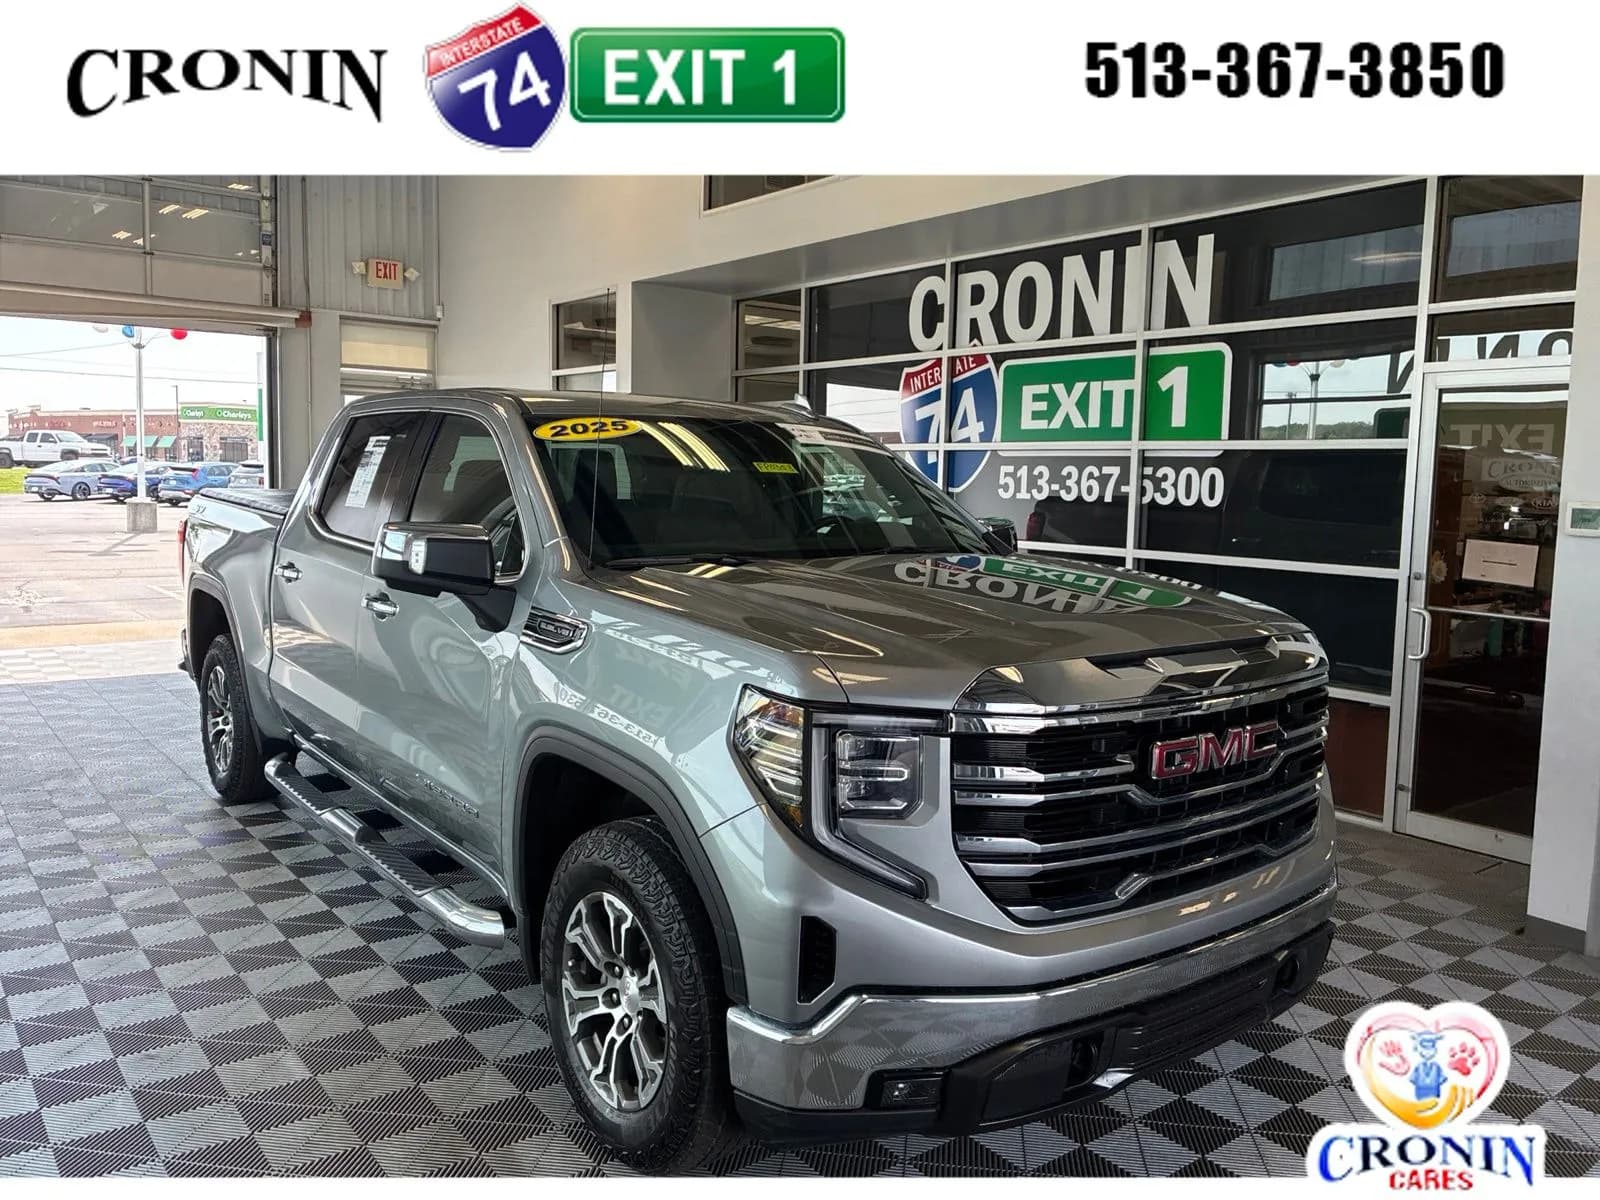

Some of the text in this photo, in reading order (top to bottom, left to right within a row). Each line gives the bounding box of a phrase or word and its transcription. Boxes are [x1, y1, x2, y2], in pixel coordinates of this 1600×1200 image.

[375, 261, 399, 281] EXIT
[908, 233, 1215, 351] CRONIN
[909, 355, 977, 394] INTERATE
[1020, 365, 1189, 430] EXIT 1
[549, 420, 630, 438] 2025
[915, 386, 985, 465] 74
[998, 465, 1225, 507] 513-367-5300
[1152, 720, 1279, 780] GMC
